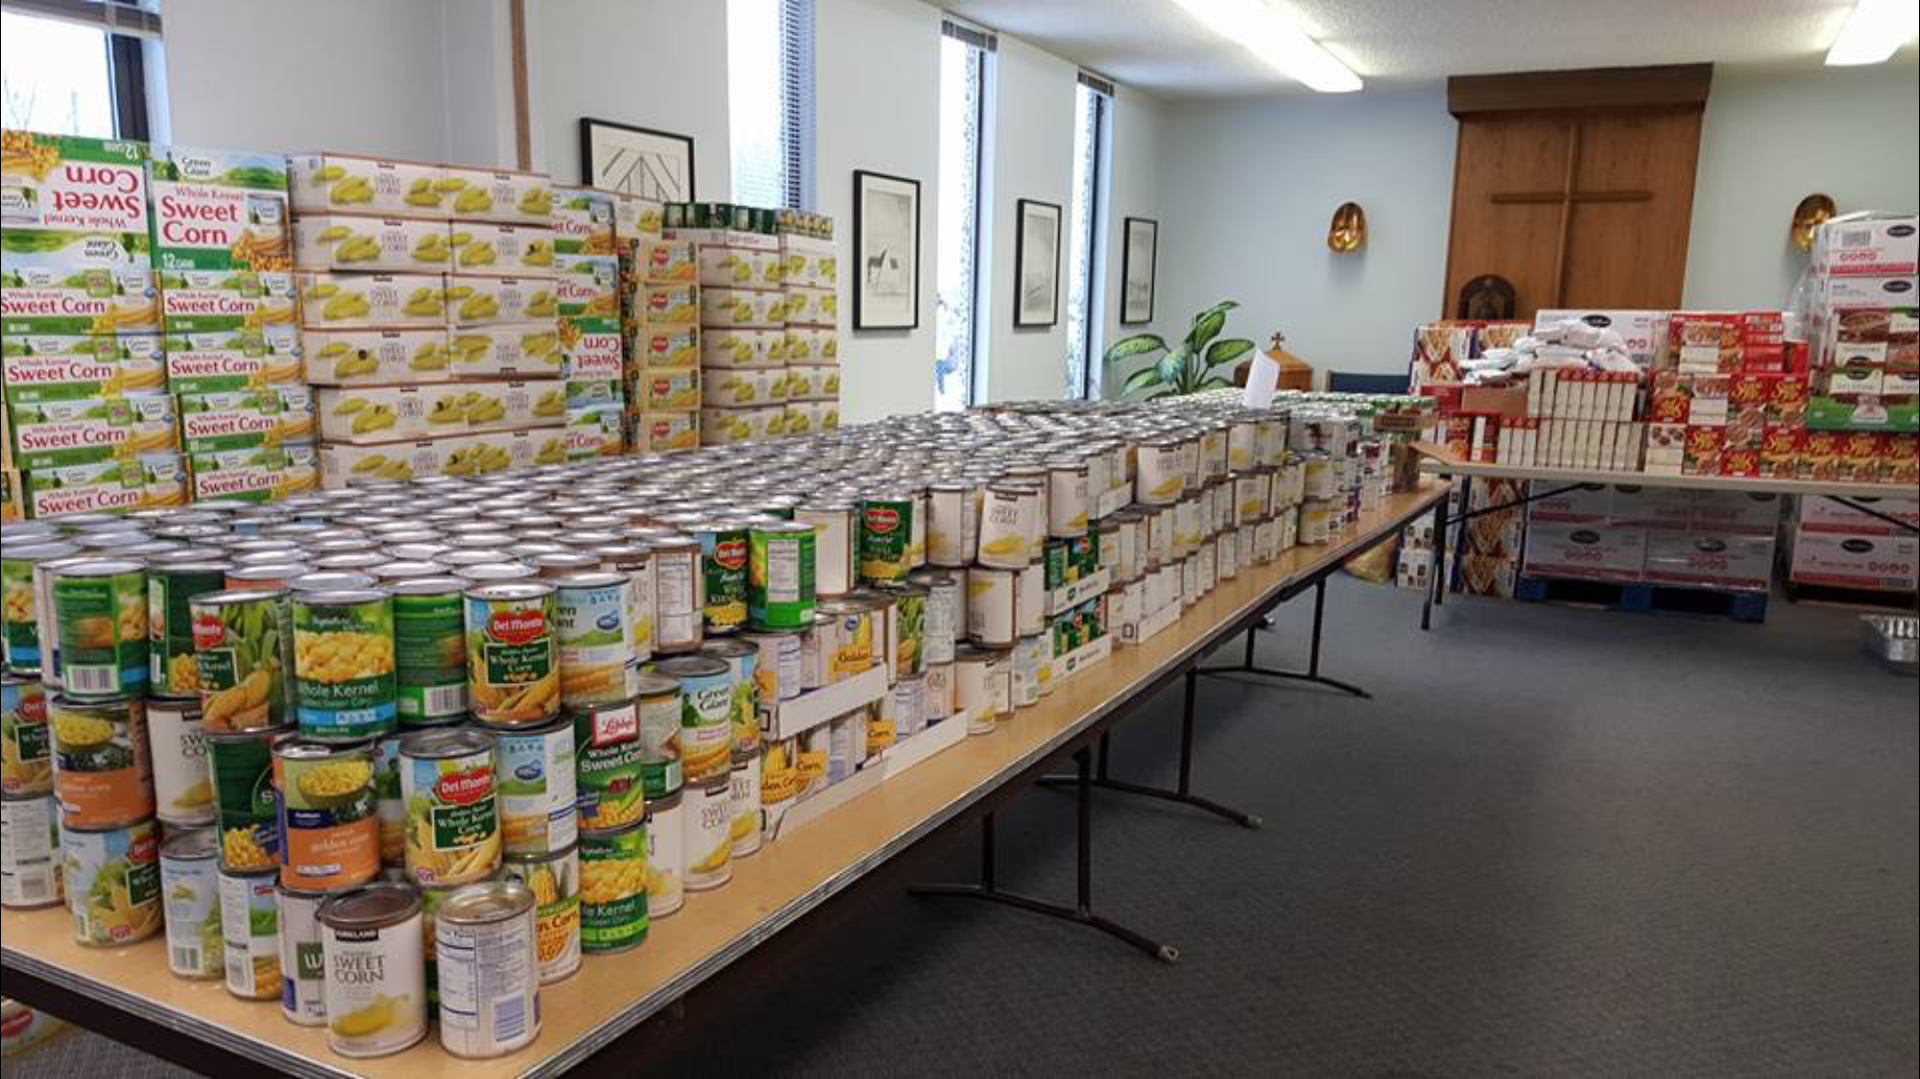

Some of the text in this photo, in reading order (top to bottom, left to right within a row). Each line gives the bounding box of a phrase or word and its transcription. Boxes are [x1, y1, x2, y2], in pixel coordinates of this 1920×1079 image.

[65, 166, 139, 193] Corn
[53, 191, 140, 218] Sweet
[162, 196, 238, 223] Sweet
[163, 222, 228, 245] Corn
[1, 299, 105, 315] Sweet Corn
[167, 298, 256, 313] Sweet Corn
[583, 336, 620, 350] Corn
[171, 358, 259, 375] Sweet Corn
[576, 355, 620, 370] Sweet
[8, 363, 113, 382] Sweet Corn
[187, 417, 275, 437] Sweet Corn
[22, 429, 126, 449] Sweet Corn
[199, 474, 280, 495] Sweet Corn
[38, 491, 139, 515] Sweet Corn
[333, 681, 379, 698] Kernel
[580, 754, 623, 773] Sweet
[598, 898, 636, 915] Kernel
[333, 954, 385, 970] SWEET
[333, 968, 385, 984] CORN
